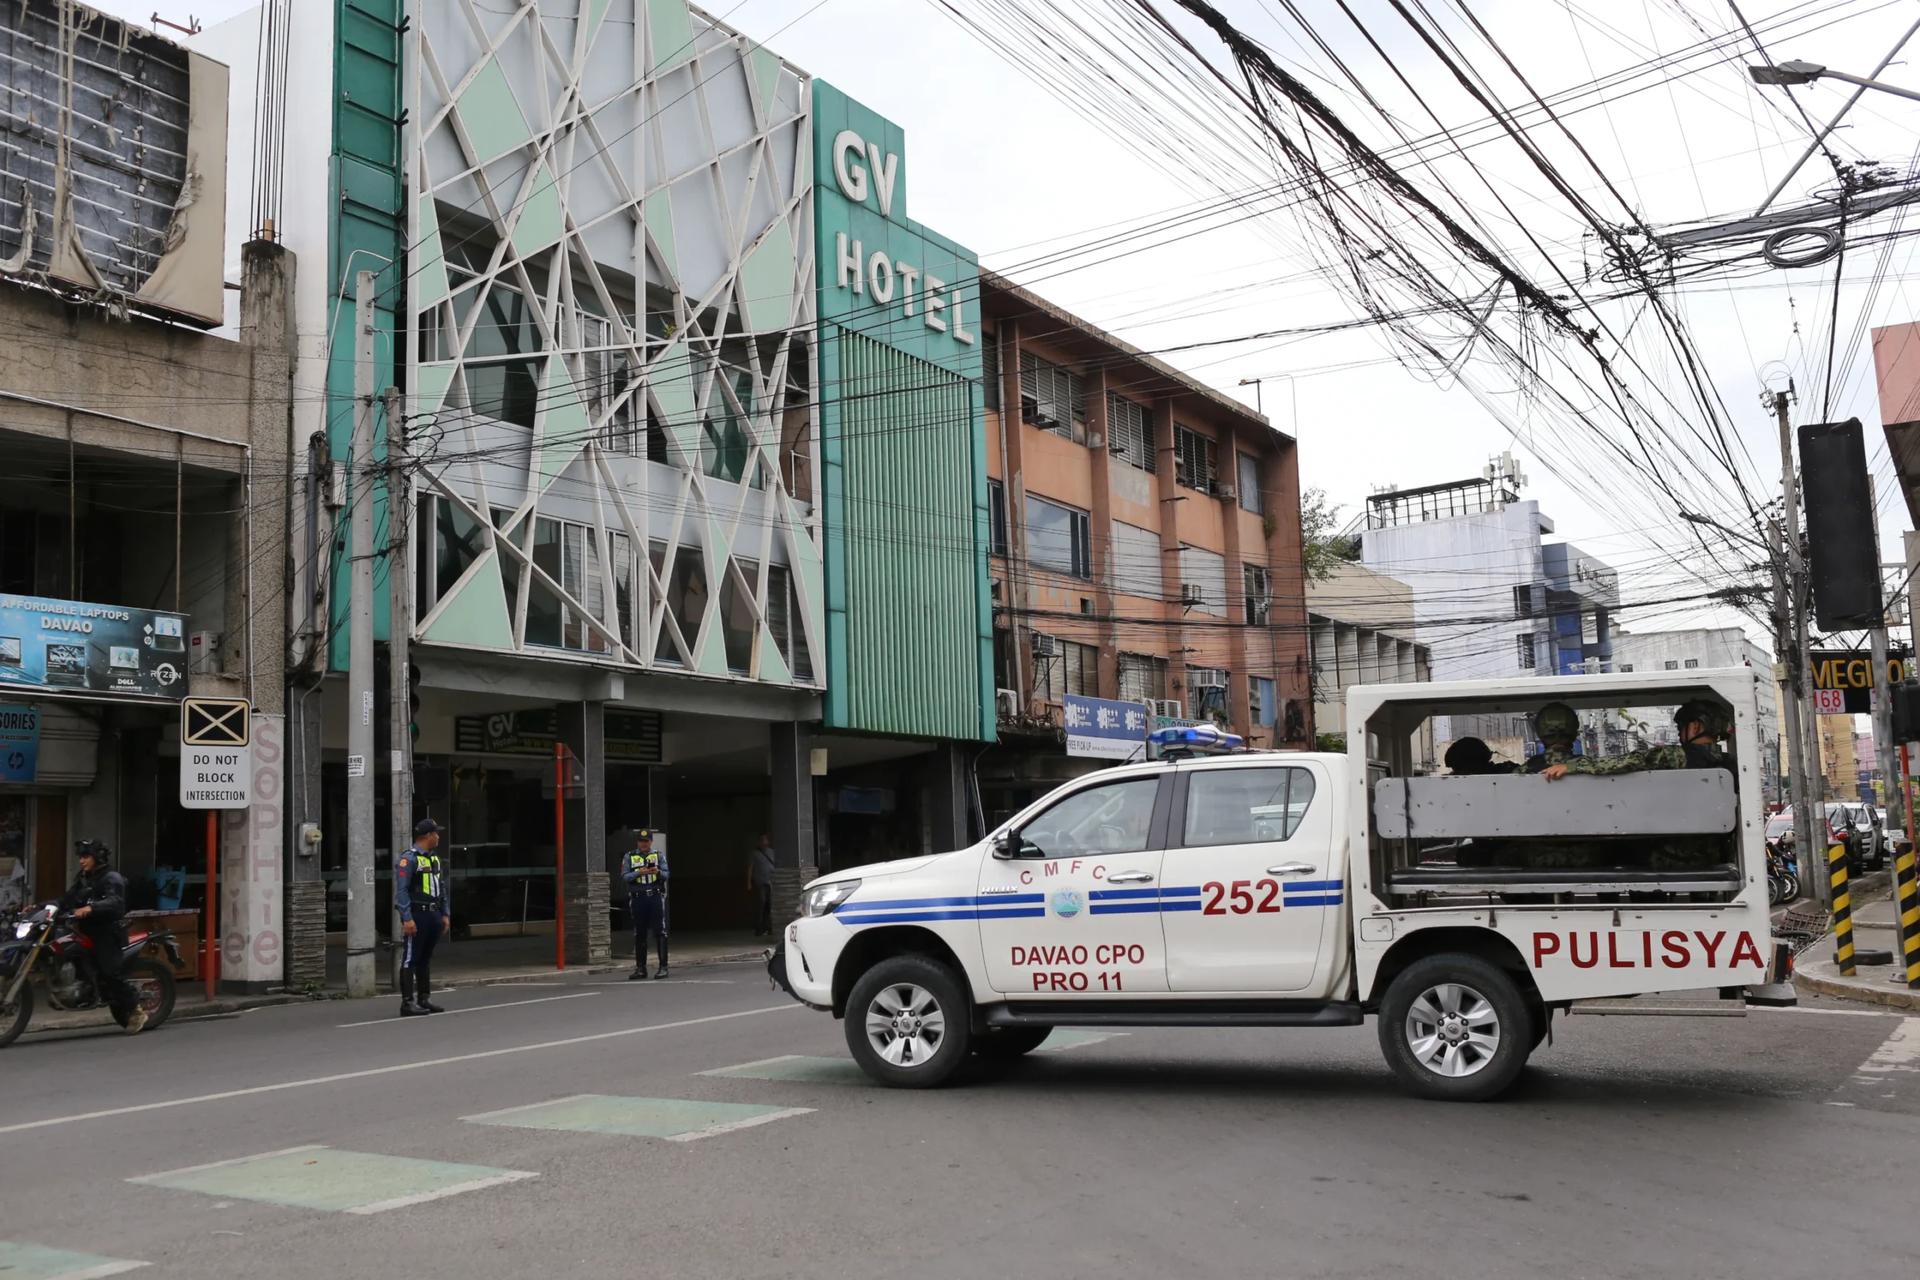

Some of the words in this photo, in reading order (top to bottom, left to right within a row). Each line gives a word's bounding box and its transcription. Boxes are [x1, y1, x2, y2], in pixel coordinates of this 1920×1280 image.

[833, 130, 898, 217] GV
[836, 231, 974, 345] HOTEL
[1, 600, 77, 615] AFFORDABLE
[80, 606, 129, 621] LAPTOPS
[41, 616, 93, 633] DAVAO
[487, 712, 514, 738] GV
[193, 754, 210, 765] DO
[215, 755, 238, 765] NOT
[197, 772, 234, 783] BLOCK
[186, 790, 245, 801] INTERSECTION
[1201, 878, 1281, 916] 252
[1011, 945, 1088, 966] DAVAO
[1095, 944, 1145, 965] CPO
[1533, 930, 1765, 969] PULISYA
[1032, 971, 1089, 991] PRO
[1098, 971, 1122, 991] 11
